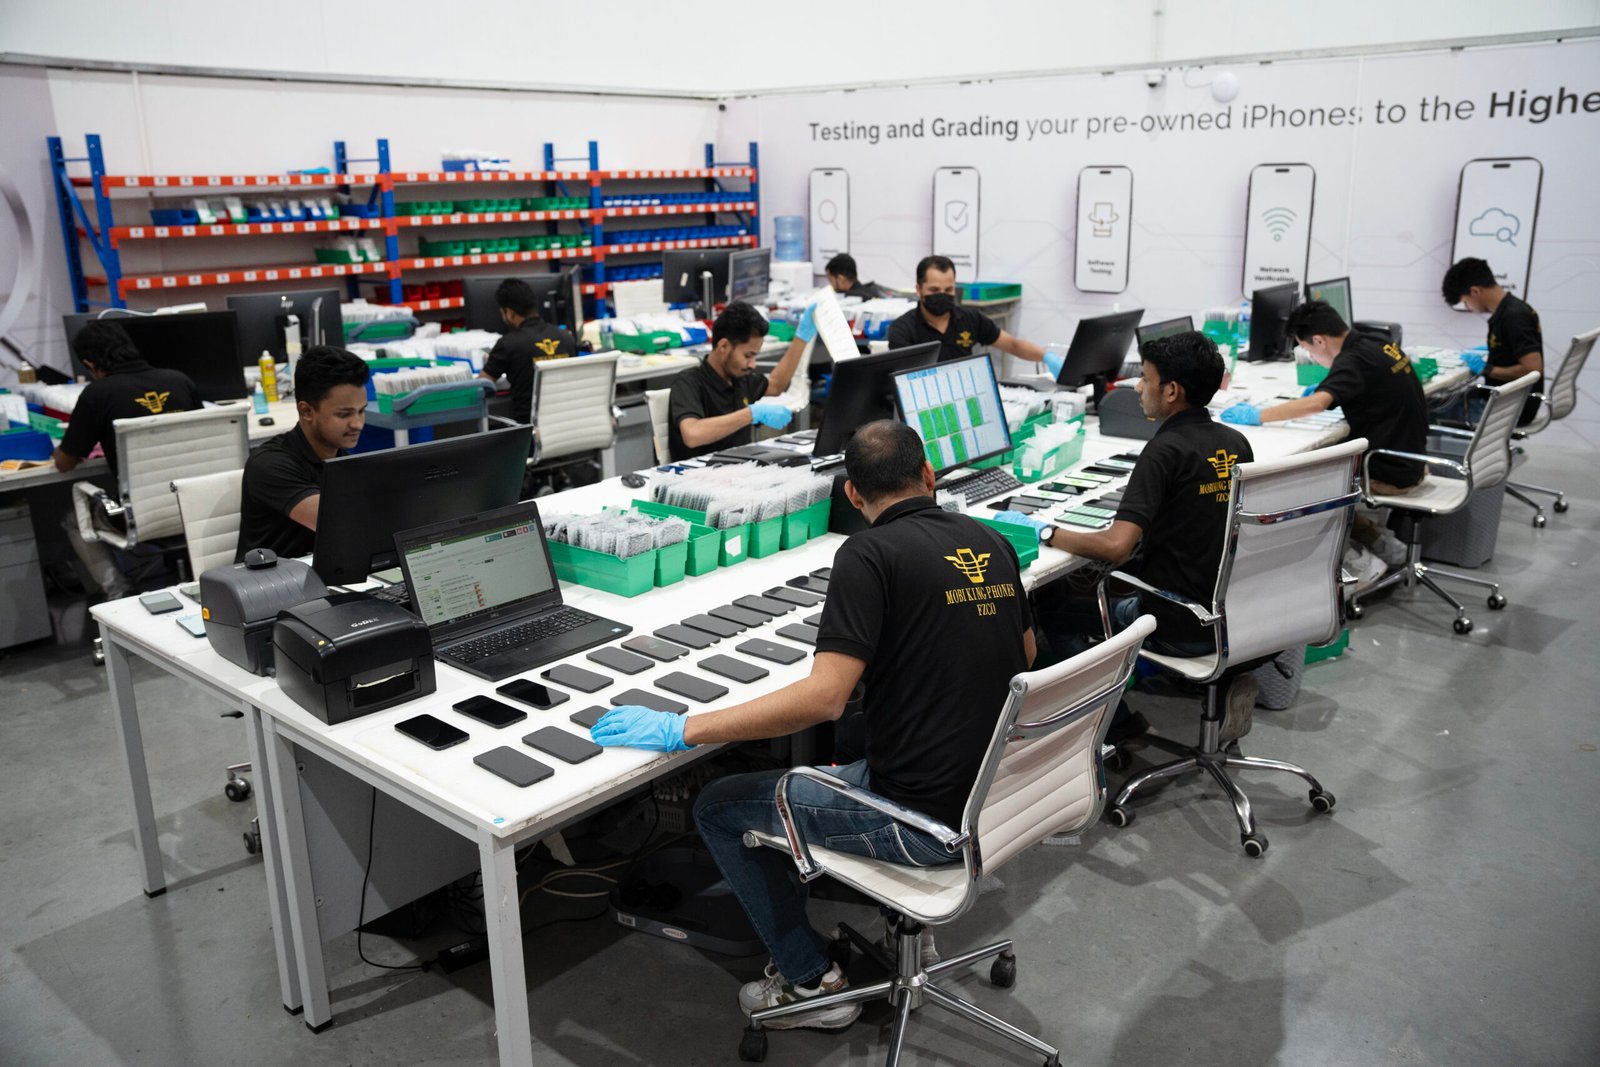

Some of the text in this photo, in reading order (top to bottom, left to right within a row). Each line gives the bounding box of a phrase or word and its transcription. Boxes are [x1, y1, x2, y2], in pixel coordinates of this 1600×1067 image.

[809, 86, 1600, 145] Testing and Grading your pre-owned iPhones to the Highe
[985, 583, 1015, 599] PHONES
[976, 602, 997, 616] FZCO
